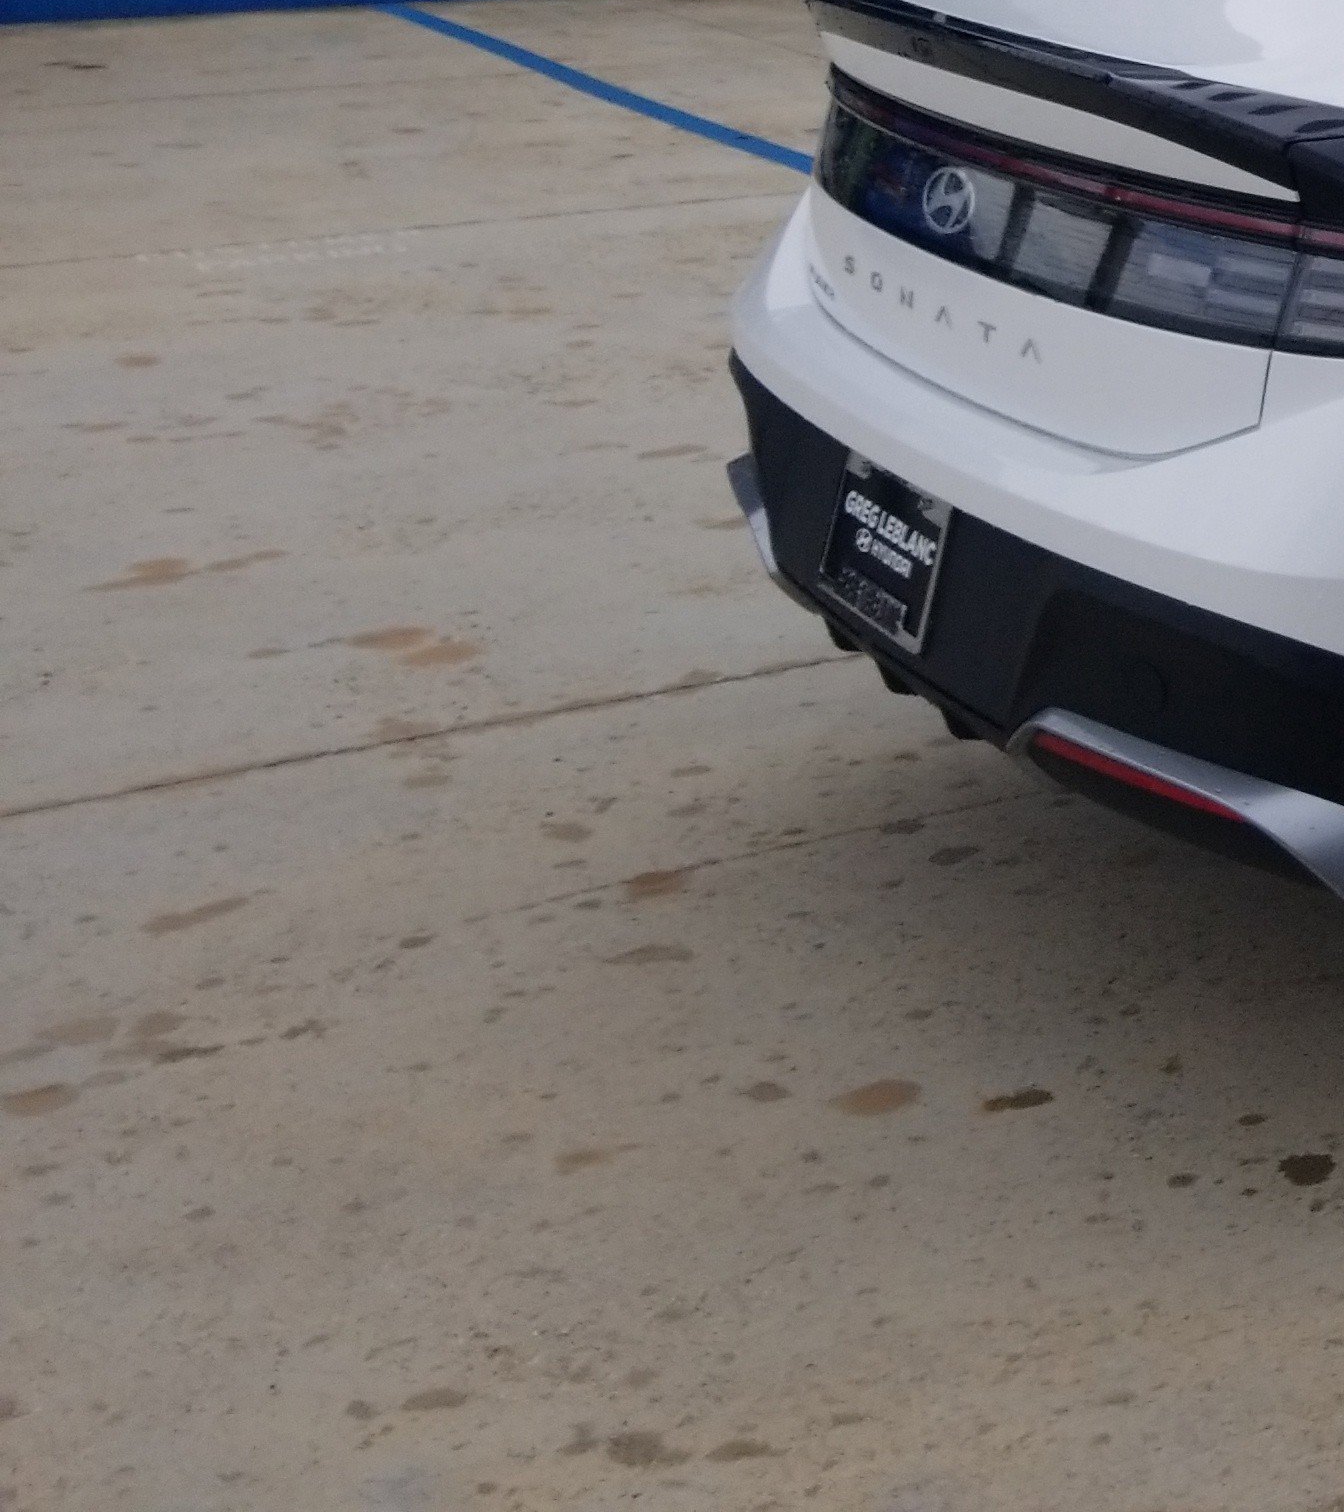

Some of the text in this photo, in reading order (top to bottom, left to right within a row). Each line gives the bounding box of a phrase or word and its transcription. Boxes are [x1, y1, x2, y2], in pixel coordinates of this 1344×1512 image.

[843, 255, 1043, 365] SONATA
[844, 489, 938, 567] GREG LEBLANC
